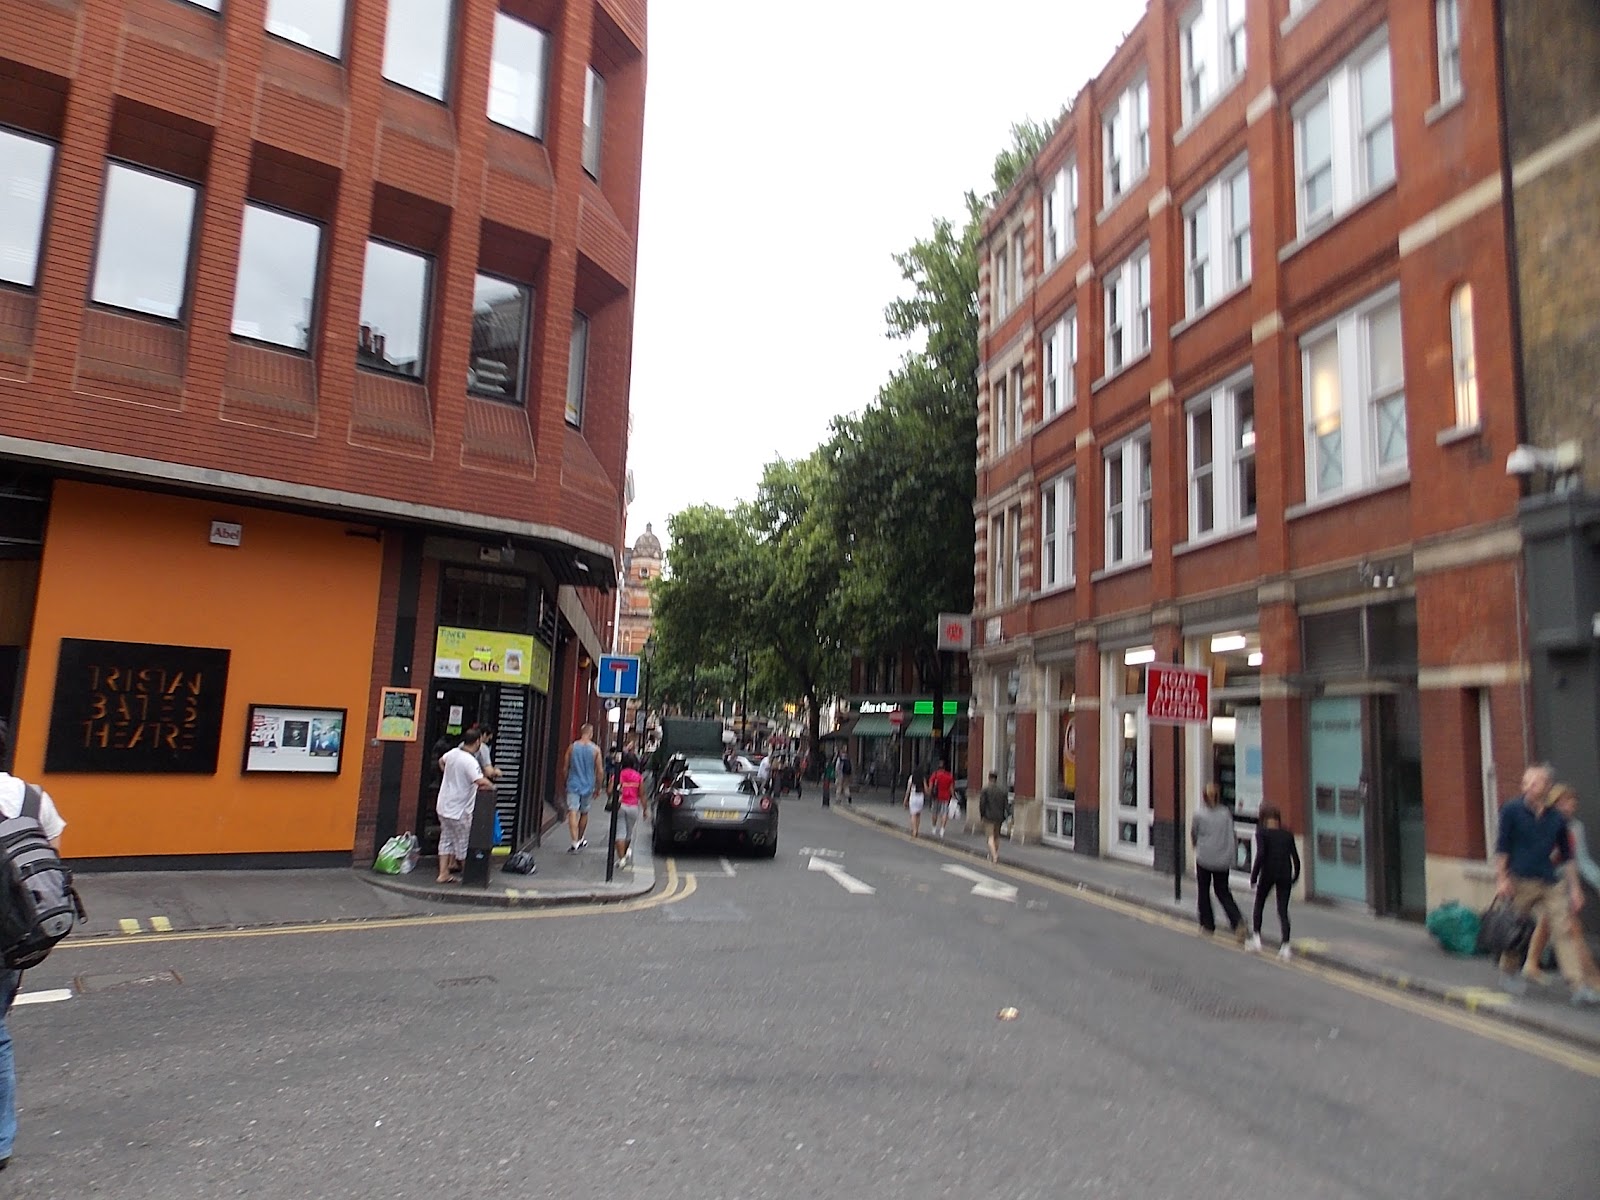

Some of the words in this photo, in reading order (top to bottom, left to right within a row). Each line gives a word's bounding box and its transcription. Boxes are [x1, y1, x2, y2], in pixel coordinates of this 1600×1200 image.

[214, 527, 240, 540] Abel
[87, 664, 202, 695] TRISTAN
[1160, 670, 1196, 688] ROAD
[1156, 686, 1200, 705] AHEAD
[91, 692, 198, 722] BATES
[1151, 701, 1204, 719] CLOSED
[82, 720, 196, 750] THEATRE
